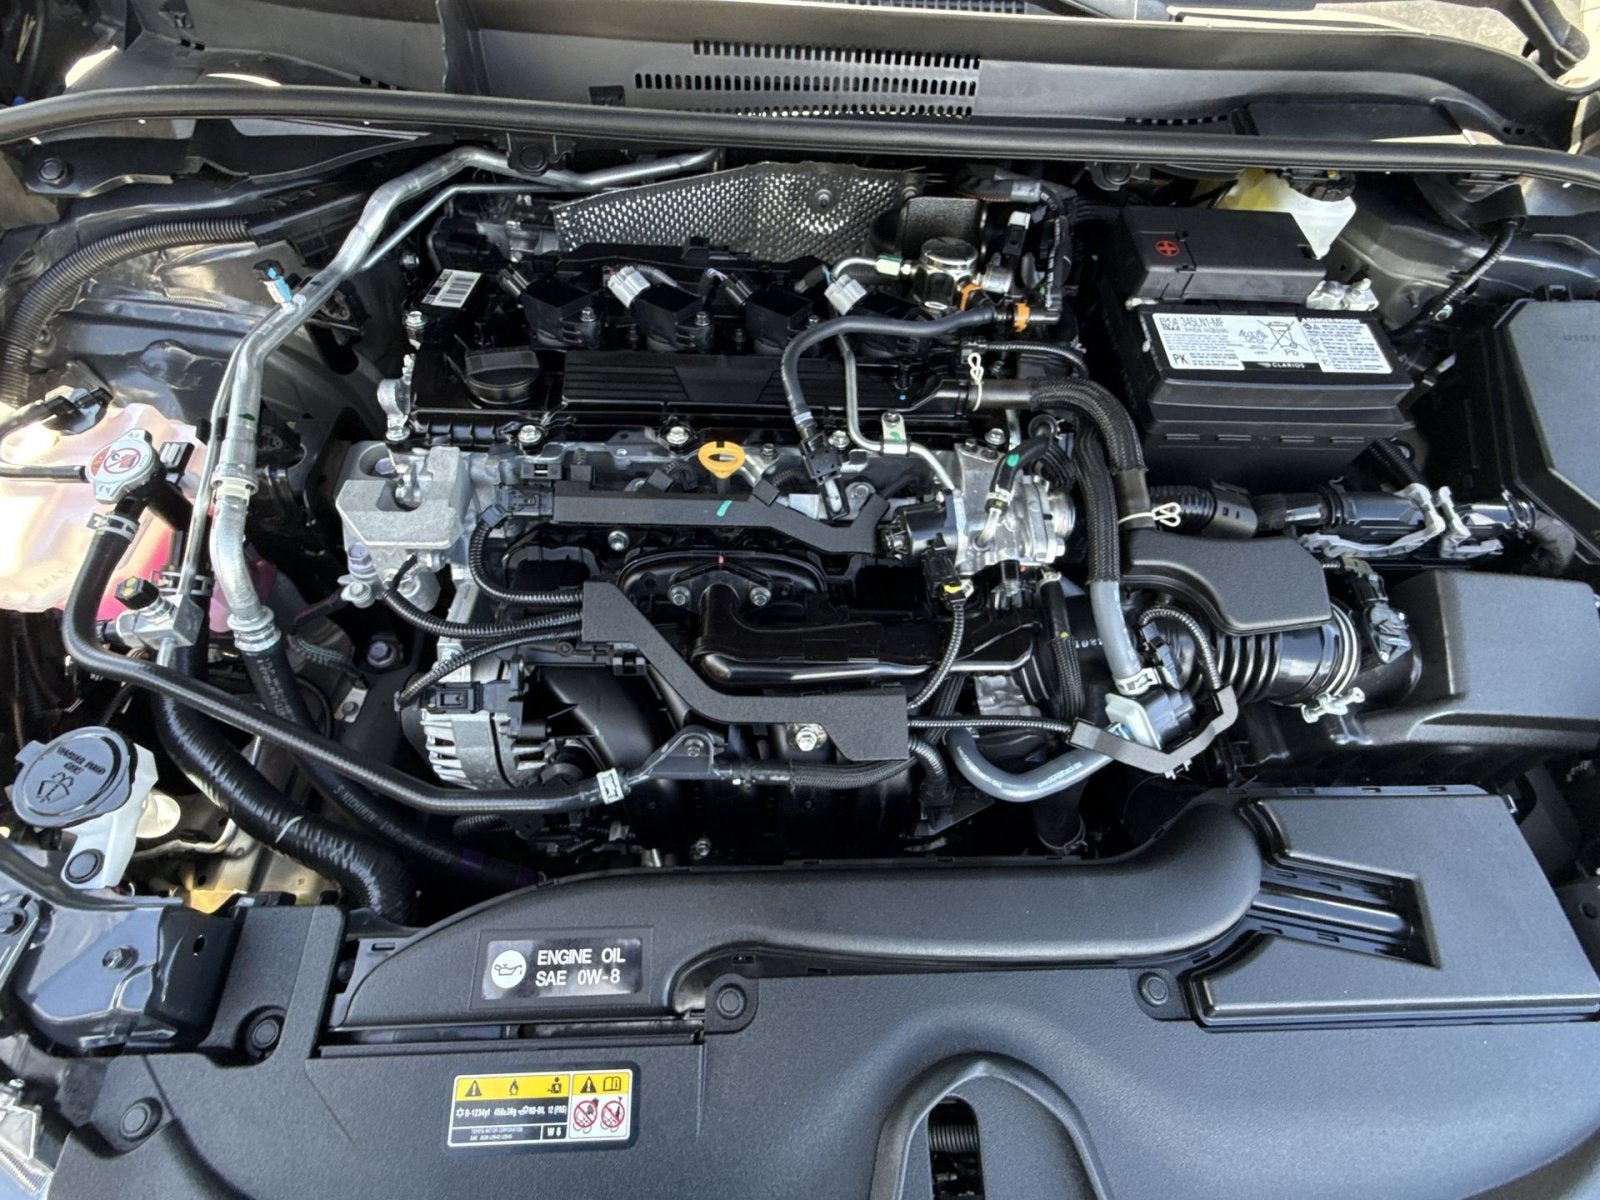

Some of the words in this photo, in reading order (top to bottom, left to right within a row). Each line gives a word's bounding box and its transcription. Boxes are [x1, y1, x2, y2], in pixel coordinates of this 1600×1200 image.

[1172, 353, 1189, 365] PK
[536, 948, 593, 966] ENGINE
[601, 947, 626, 964] OIL
[535, 970, 567, 987] SAE
[577, 968, 621, 985] 0W-8
